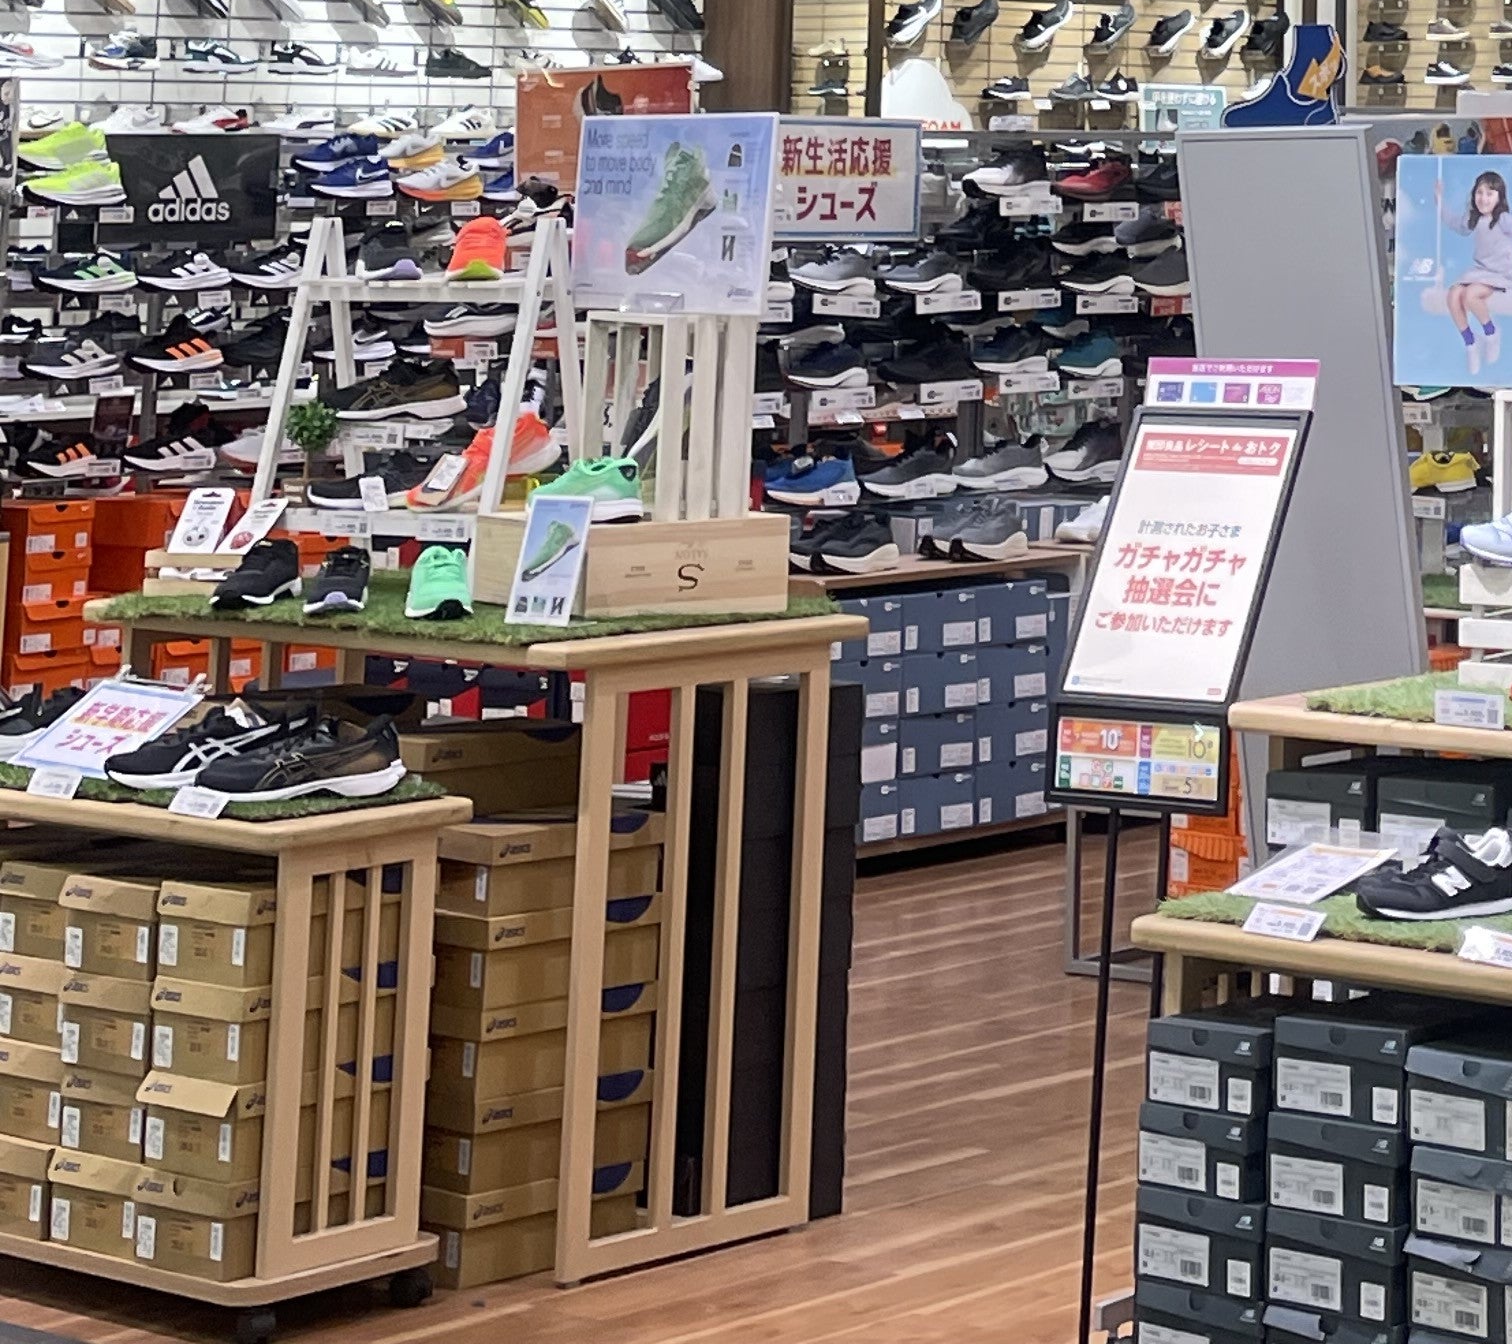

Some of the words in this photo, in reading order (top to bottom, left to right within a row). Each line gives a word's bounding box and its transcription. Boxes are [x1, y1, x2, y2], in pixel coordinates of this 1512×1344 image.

[781, 135, 892, 177] 新生活応援
[148, 197, 231, 223] adidas
[796, 181, 879, 222] シューズ
[1113, 541, 1248, 576] ガチャガチャ
[1122, 574, 1221, 608] 抽選会に
[1094, 611, 1234, 638] ご参加いただけます
